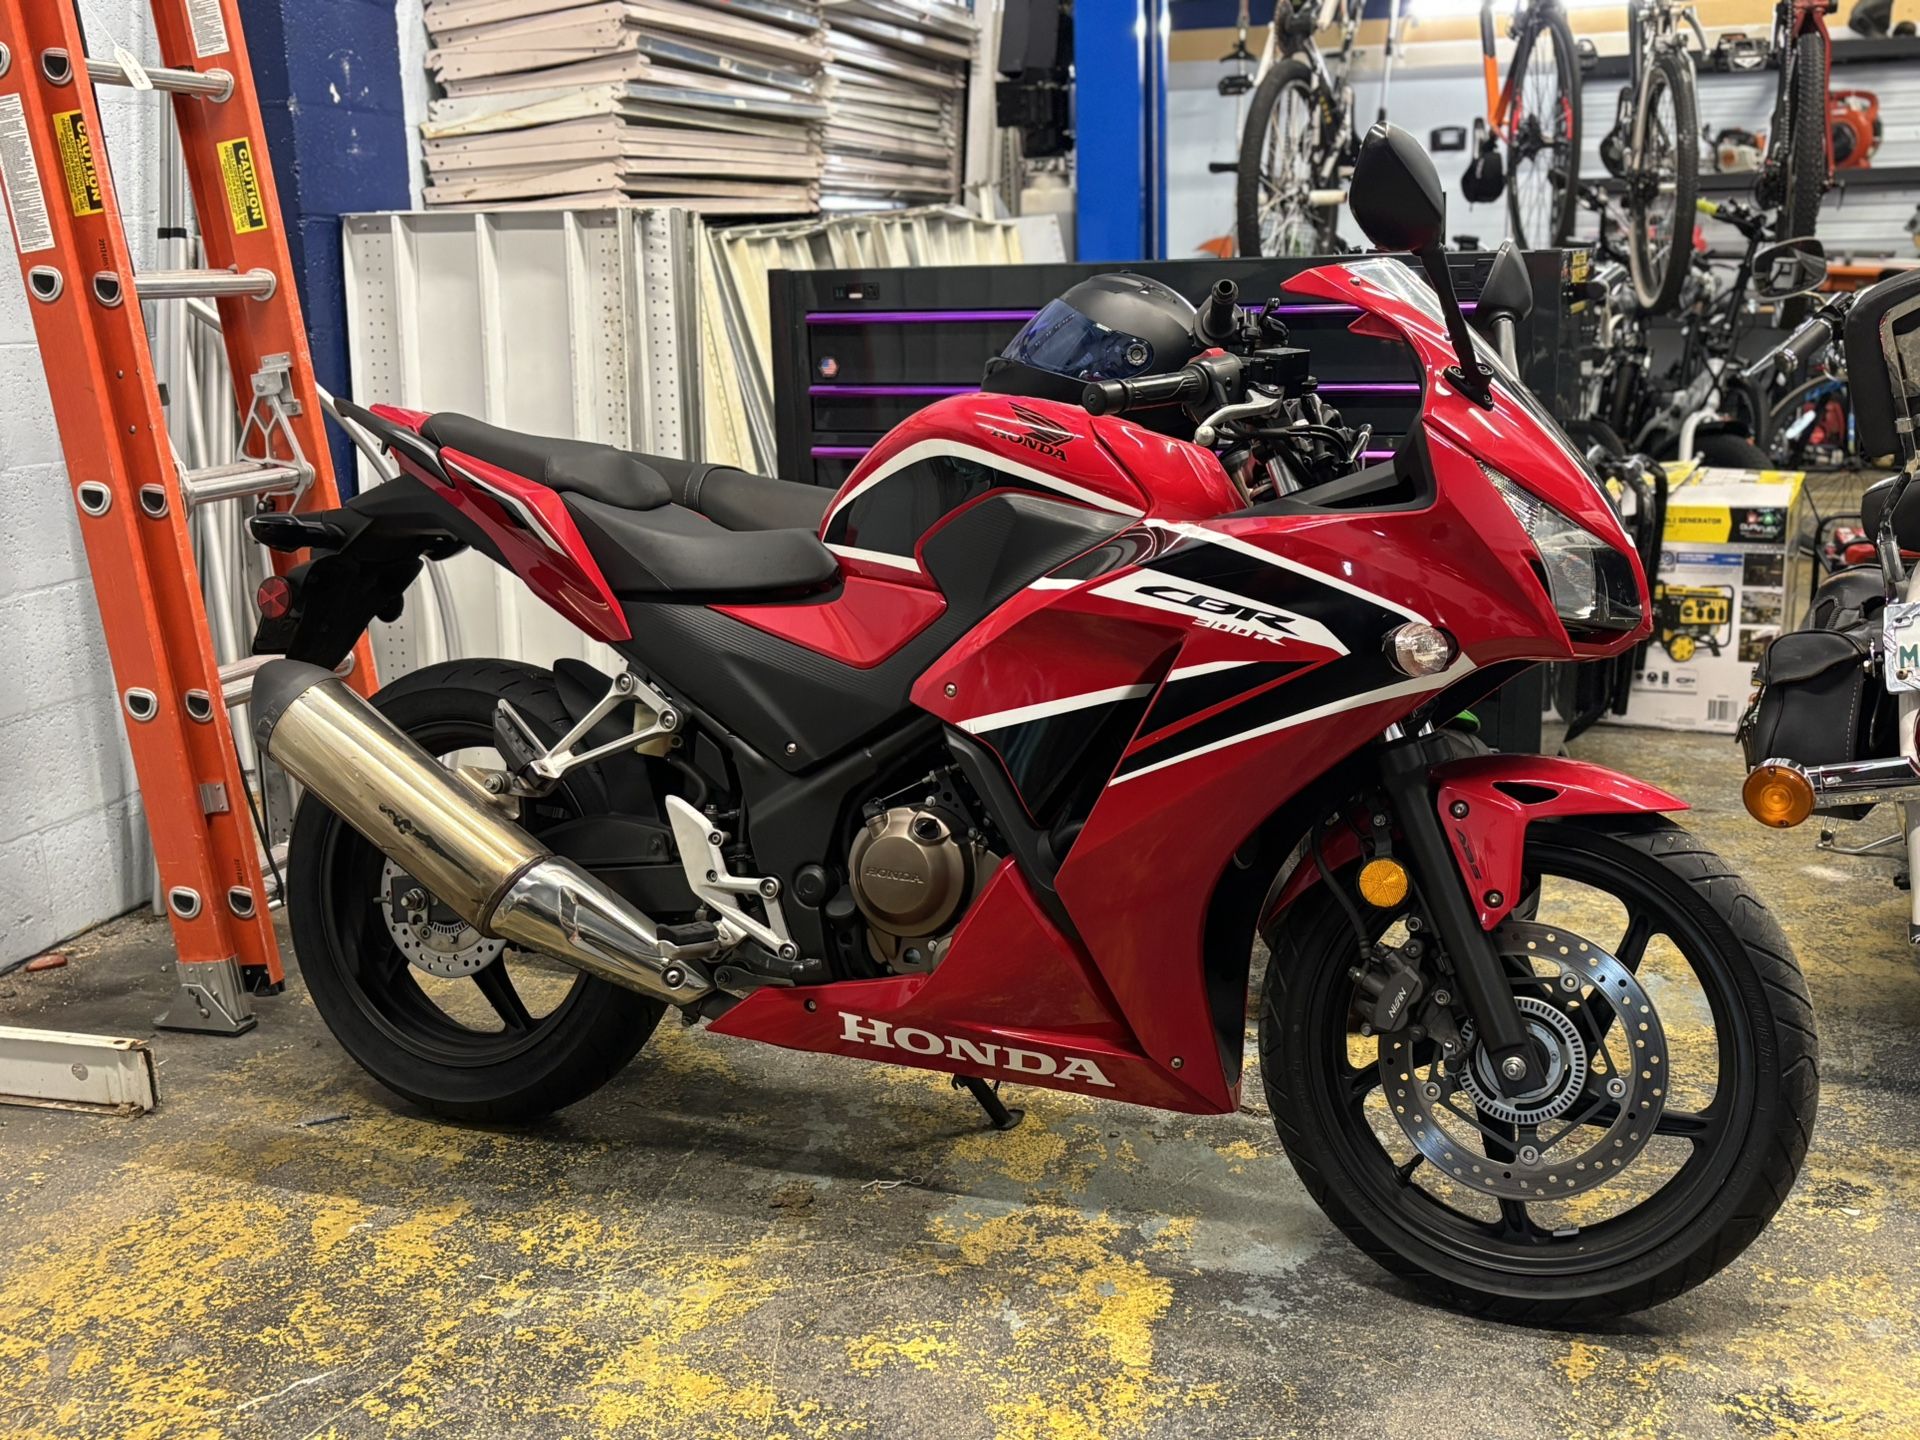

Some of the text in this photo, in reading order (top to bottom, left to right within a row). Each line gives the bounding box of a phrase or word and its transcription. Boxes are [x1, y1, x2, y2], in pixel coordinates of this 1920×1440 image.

[77, 121, 101, 200] CAUTION
[238, 148, 262, 219] CAUTION
[991, 430, 1067, 462] HONDA
[1134, 586, 1300, 637] CBR
[1192, 618, 1286, 647] 300R
[865, 866, 924, 884] HONDA
[838, 1011, 1116, 1088] HONDA
